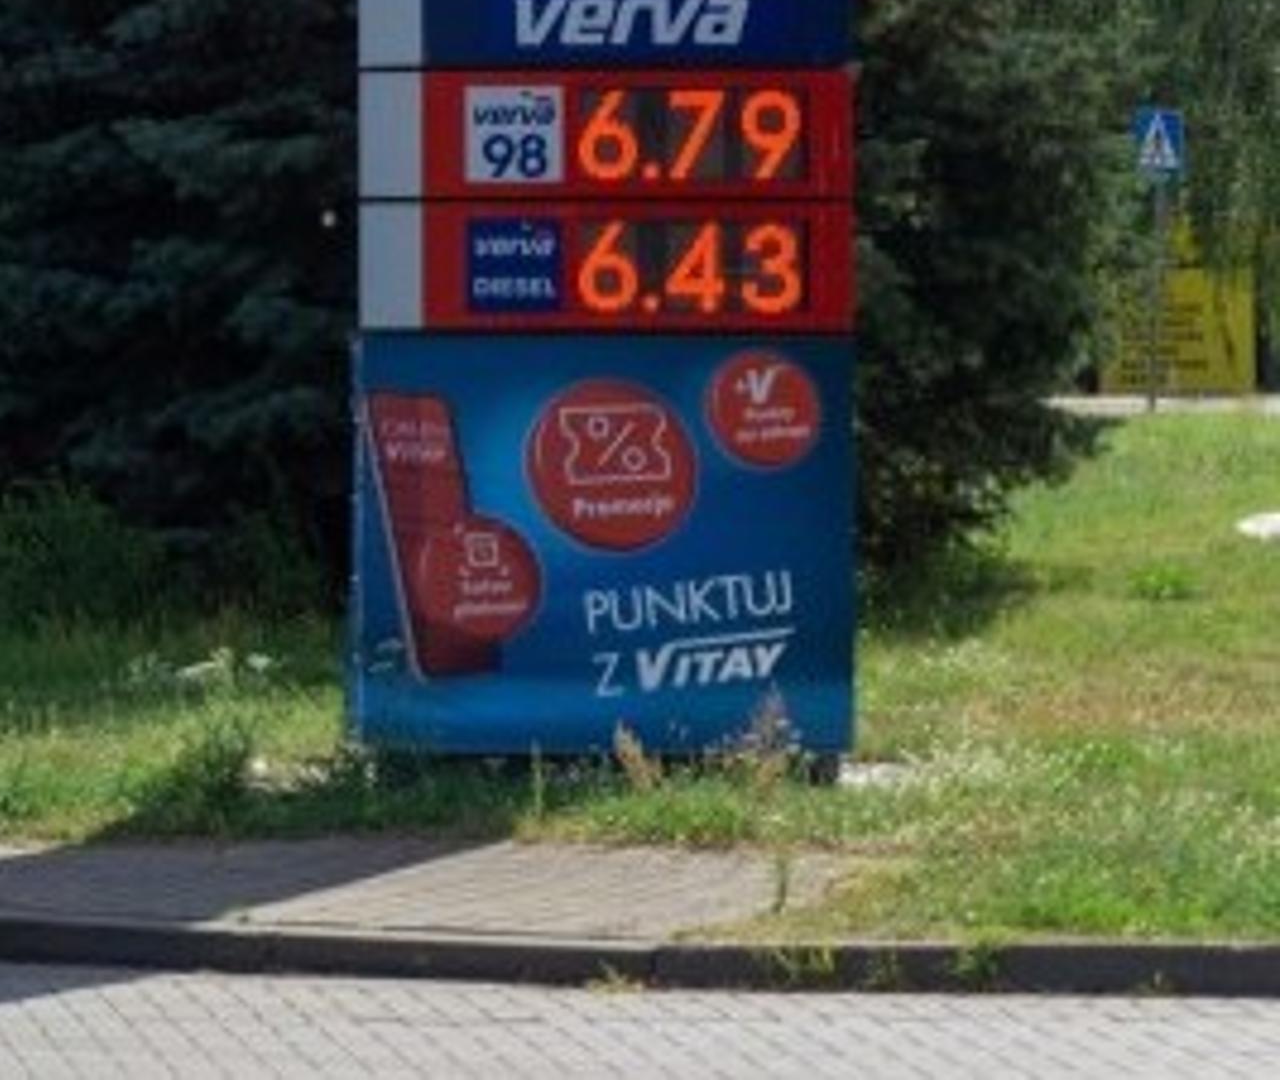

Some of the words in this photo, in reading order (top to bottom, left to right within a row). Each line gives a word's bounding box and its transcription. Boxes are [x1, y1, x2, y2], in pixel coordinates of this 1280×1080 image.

[473, 100, 557, 126] verva
[577, 89, 802, 180] 6.79
[482, 133, 548, 179] 98
[472, 276, 556, 299] DIESEL
[577, 221, 802, 313] 6.43
[583, 571, 792, 633] PUNKTUJ
[594, 653, 622, 698] Z
[637, 626, 797, 690] VITAY
